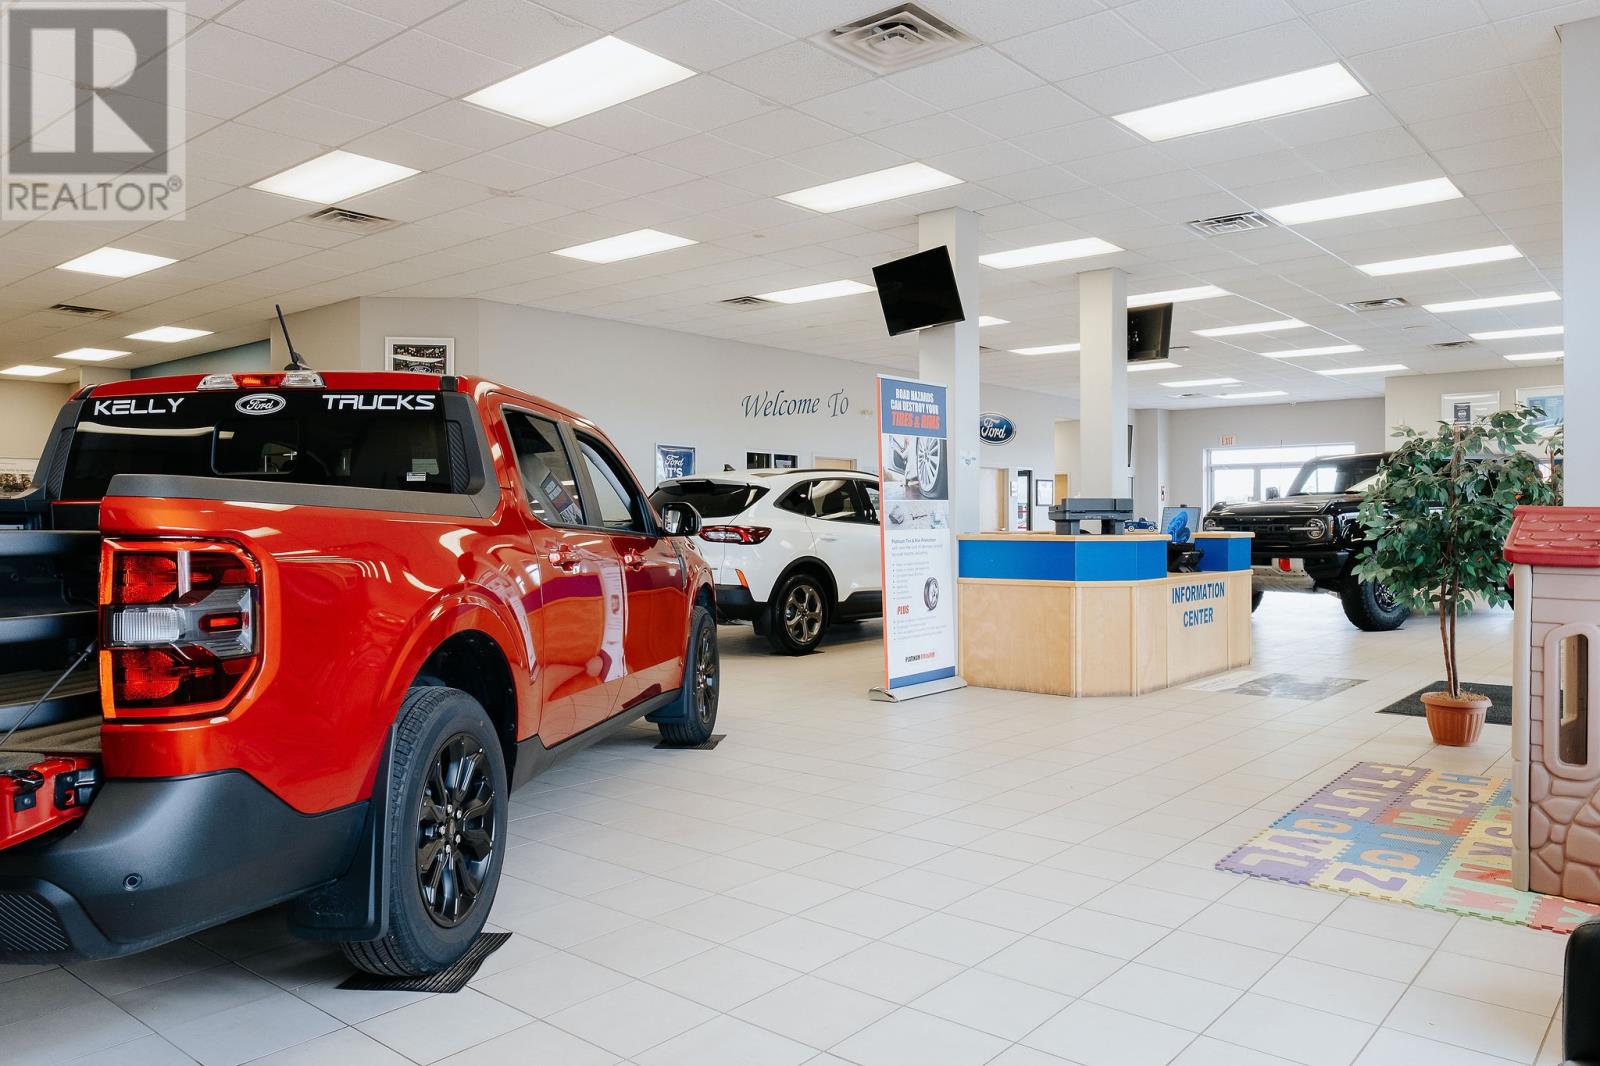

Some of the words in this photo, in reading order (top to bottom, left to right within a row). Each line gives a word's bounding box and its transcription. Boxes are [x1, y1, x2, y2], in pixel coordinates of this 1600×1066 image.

[94, 397, 185, 416] KELLY
[322, 394, 436, 411] TRUCKS
[741, 389, 821, 418] Welcome
[827, 388, 849, 418] To
[895, 388, 910, 400] ROAD
[910, 390, 935, 403] HAZARDS
[890, 399, 902, 411] CAN
[902, 400, 926, 413] DESTROY
[925, 402, 940, 415] YOUR
[981, 417, 1007, 438] Ford
[1221, 436, 1233, 446] EXIT
[664, 454, 684, 466] Ford
[1171, 581, 1225, 605] INFORMATION
[1183, 607, 1214, 628] CENTER
